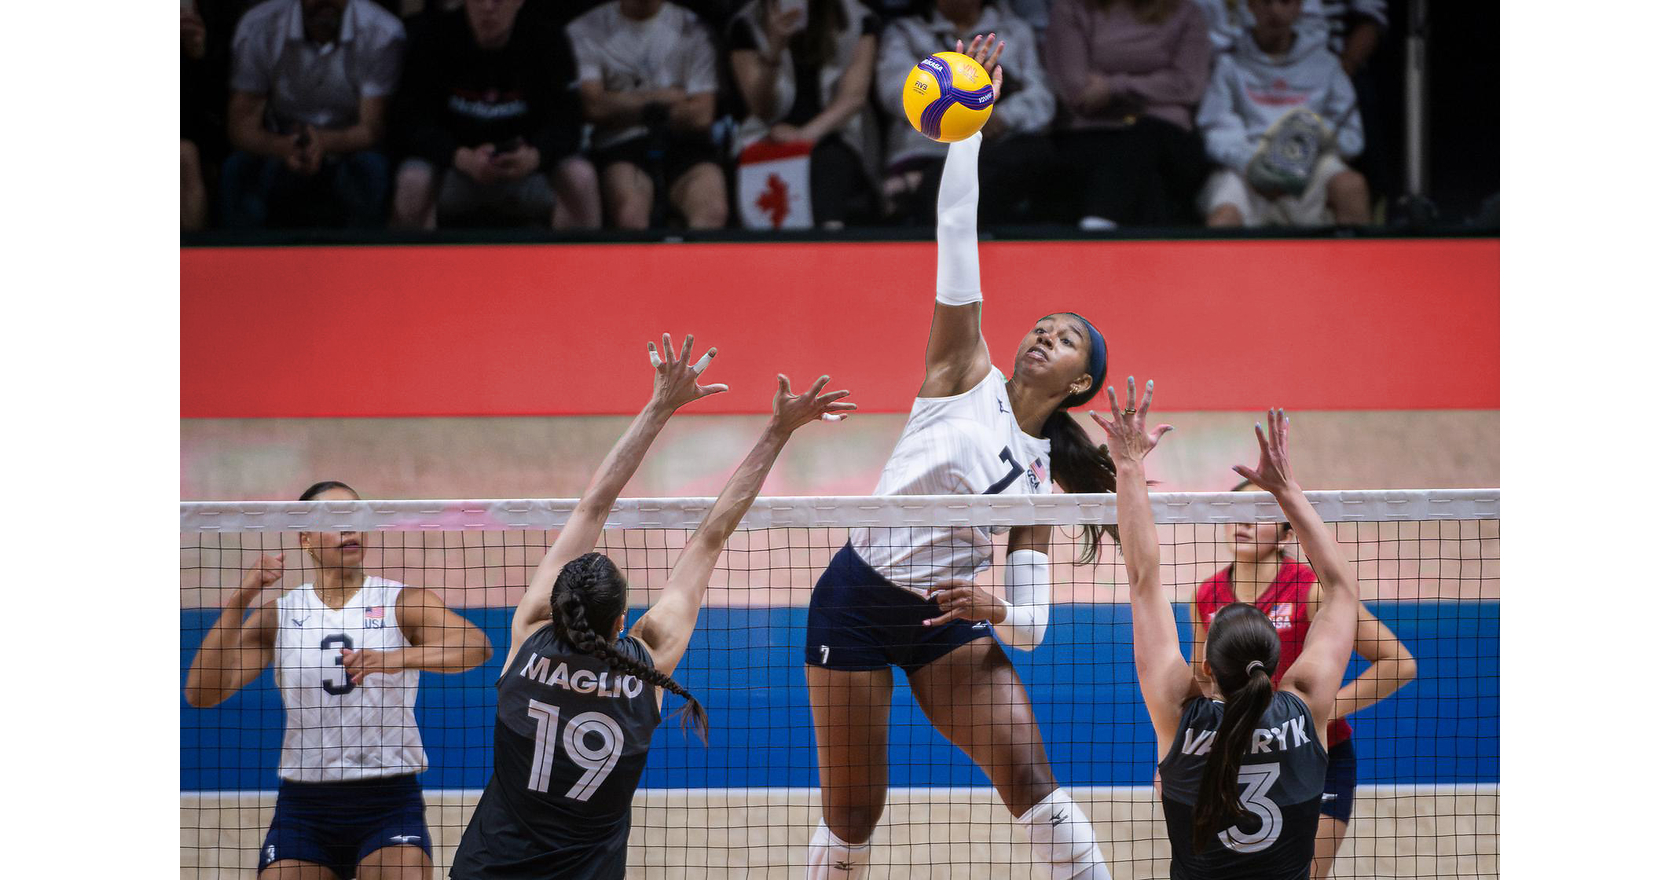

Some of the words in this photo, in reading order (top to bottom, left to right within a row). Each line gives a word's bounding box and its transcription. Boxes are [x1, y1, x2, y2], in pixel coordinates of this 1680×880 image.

[914, 80, 928, 91] FIVB
[981, 445, 1026, 494] 7
[364, 618, 386, 629] USA
[321, 633, 356, 695] 3
[519, 652, 643, 699] MAGLIO
[820, 644, 830, 664] 7
[527, 698, 625, 802] 19
[1181, 714, 1311, 756] VARYK
[1217, 762, 1284, 853] 3
